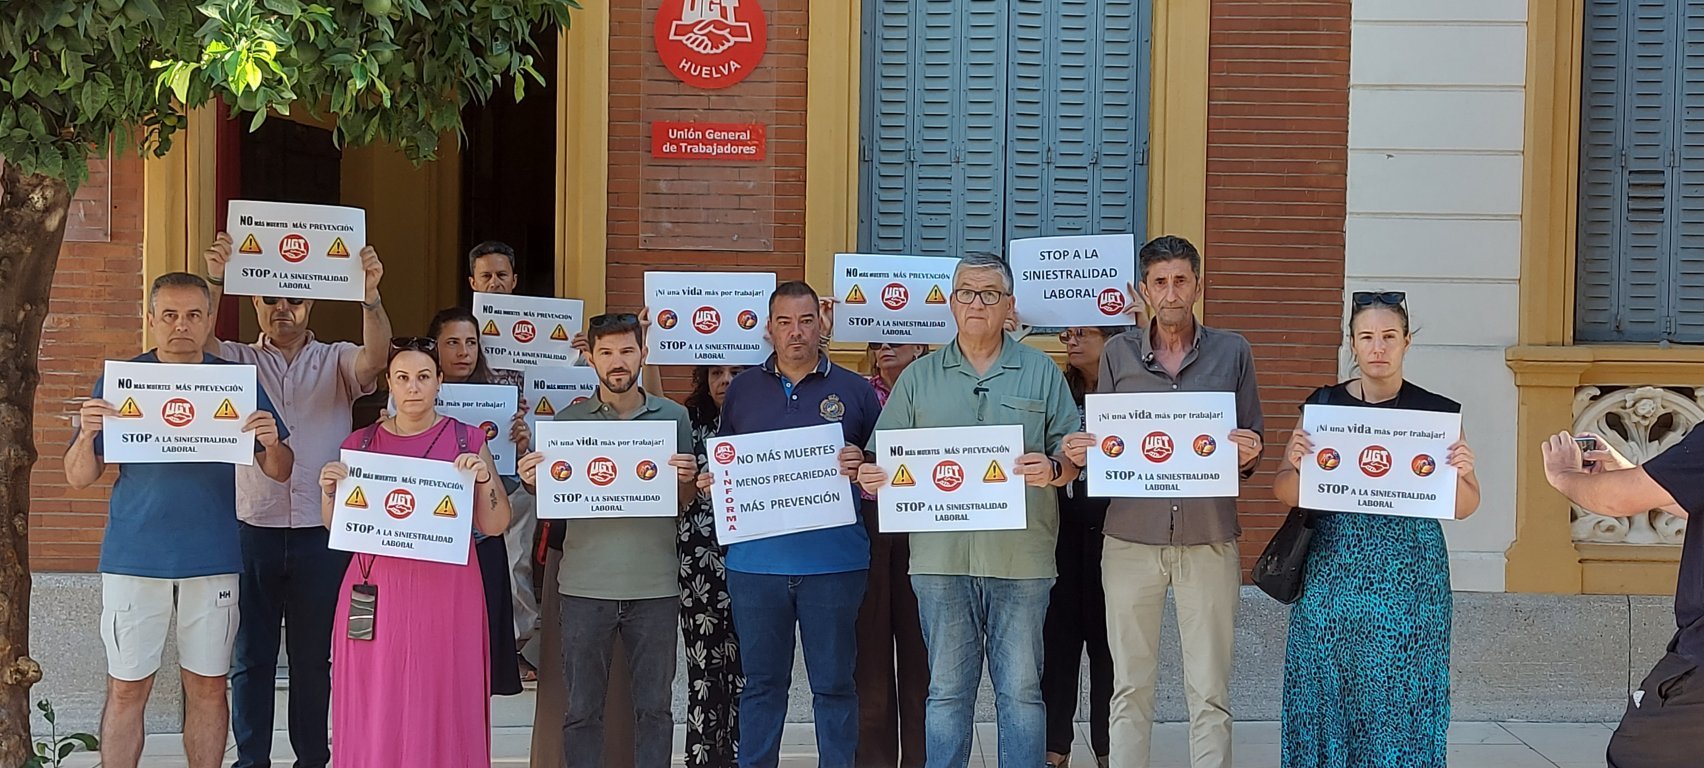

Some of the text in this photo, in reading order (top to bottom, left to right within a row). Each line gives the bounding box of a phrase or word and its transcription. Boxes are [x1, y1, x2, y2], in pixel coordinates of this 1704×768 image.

[682, 0, 739, 24] UGT
[679, 58, 741, 78] HUELVA
[668, 127, 750, 140] Unión General
[663, 142, 756, 155] de Trabajadores
[240, 216, 253, 226] NO
[309, 223, 354, 232] PREVENCIÓN
[282, 238, 306, 250] UGT
[1040, 249, 1098, 260] STOP A LA
[242, 268, 270, 278] STOP
[290, 273, 349, 282] SINIESTRALIDAD
[846, 268, 857, 277] NO
[1022, 268, 1117, 281] SINIESTRALIDAD
[279, 282, 312, 290] LABORAL
[682, 287, 702, 295] vida
[885, 287, 906, 298] UGT
[1043, 289, 1097, 299] LABORAL
[1101, 292, 1121, 303] UGT
[483, 305, 493, 314] NO
[696, 310, 717, 321] UGT
[848, 317, 874, 326] STOP
[515, 324, 532, 332] UGT
[660, 341, 687, 350] STOP
[484, 347, 507, 355] STOP
[522, 352, 567, 360] SINIESTRALIDAD
[118, 379, 132, 389] NO
[175, 383, 191, 391] MÁS
[194, 384, 243, 392] PREVENCIÓN
[534, 380, 545, 389] NO
[165, 402, 191, 415] UGT
[1129, 410, 1152, 419] vida
[1189, 412, 1223, 420] trabajar!
[1347, 424, 1371, 434] vida
[1409, 431, 1446, 439] trabajar!
[122, 434, 152, 443] STOP
[174, 436, 238, 444] SINIESTRALIDAD
[576, 437, 598, 446] vida
[633, 439, 665, 447] trabajar!
[1146, 436, 1169, 449] UGT
[737, 445, 835, 465] NO MÁS MUERTES
[890, 446, 904, 456] NO
[944, 446, 960, 454] MÁS
[962, 445, 1010, 454] PREVENCIÓN
[1364, 449, 1389, 464] UGT
[591, 462, 614, 473] UGT
[937, 466, 960, 479] UGT
[349, 467, 362, 478] NO
[401, 476, 416, 485] MÁS
[419, 479, 464, 490] PREVENCIÓN
[736, 468, 837, 488] MENOS PRECARIEDAD
[1105, 471, 1135, 480] STOP
[1318, 484, 1349, 494] STOP
[1370, 490, 1437, 500] SINIESTRALIDAD
[388, 493, 412, 507] UGT
[554, 494, 582, 503] STOP
[723, 470, 737, 531] INFORMA
[740, 491, 840, 513] MÁS PREVENCIÓN
[1358, 499, 1394, 508] LABORAL
[896, 502, 926, 512] STOP
[946, 502, 1008, 510] SINIESTRALIDAD
[346, 522, 374, 534] STOP
[394, 530, 453, 544] SINIESTRALIDAD
[382, 540, 415, 549] LABORAL
[219, 590, 230, 599] HH
